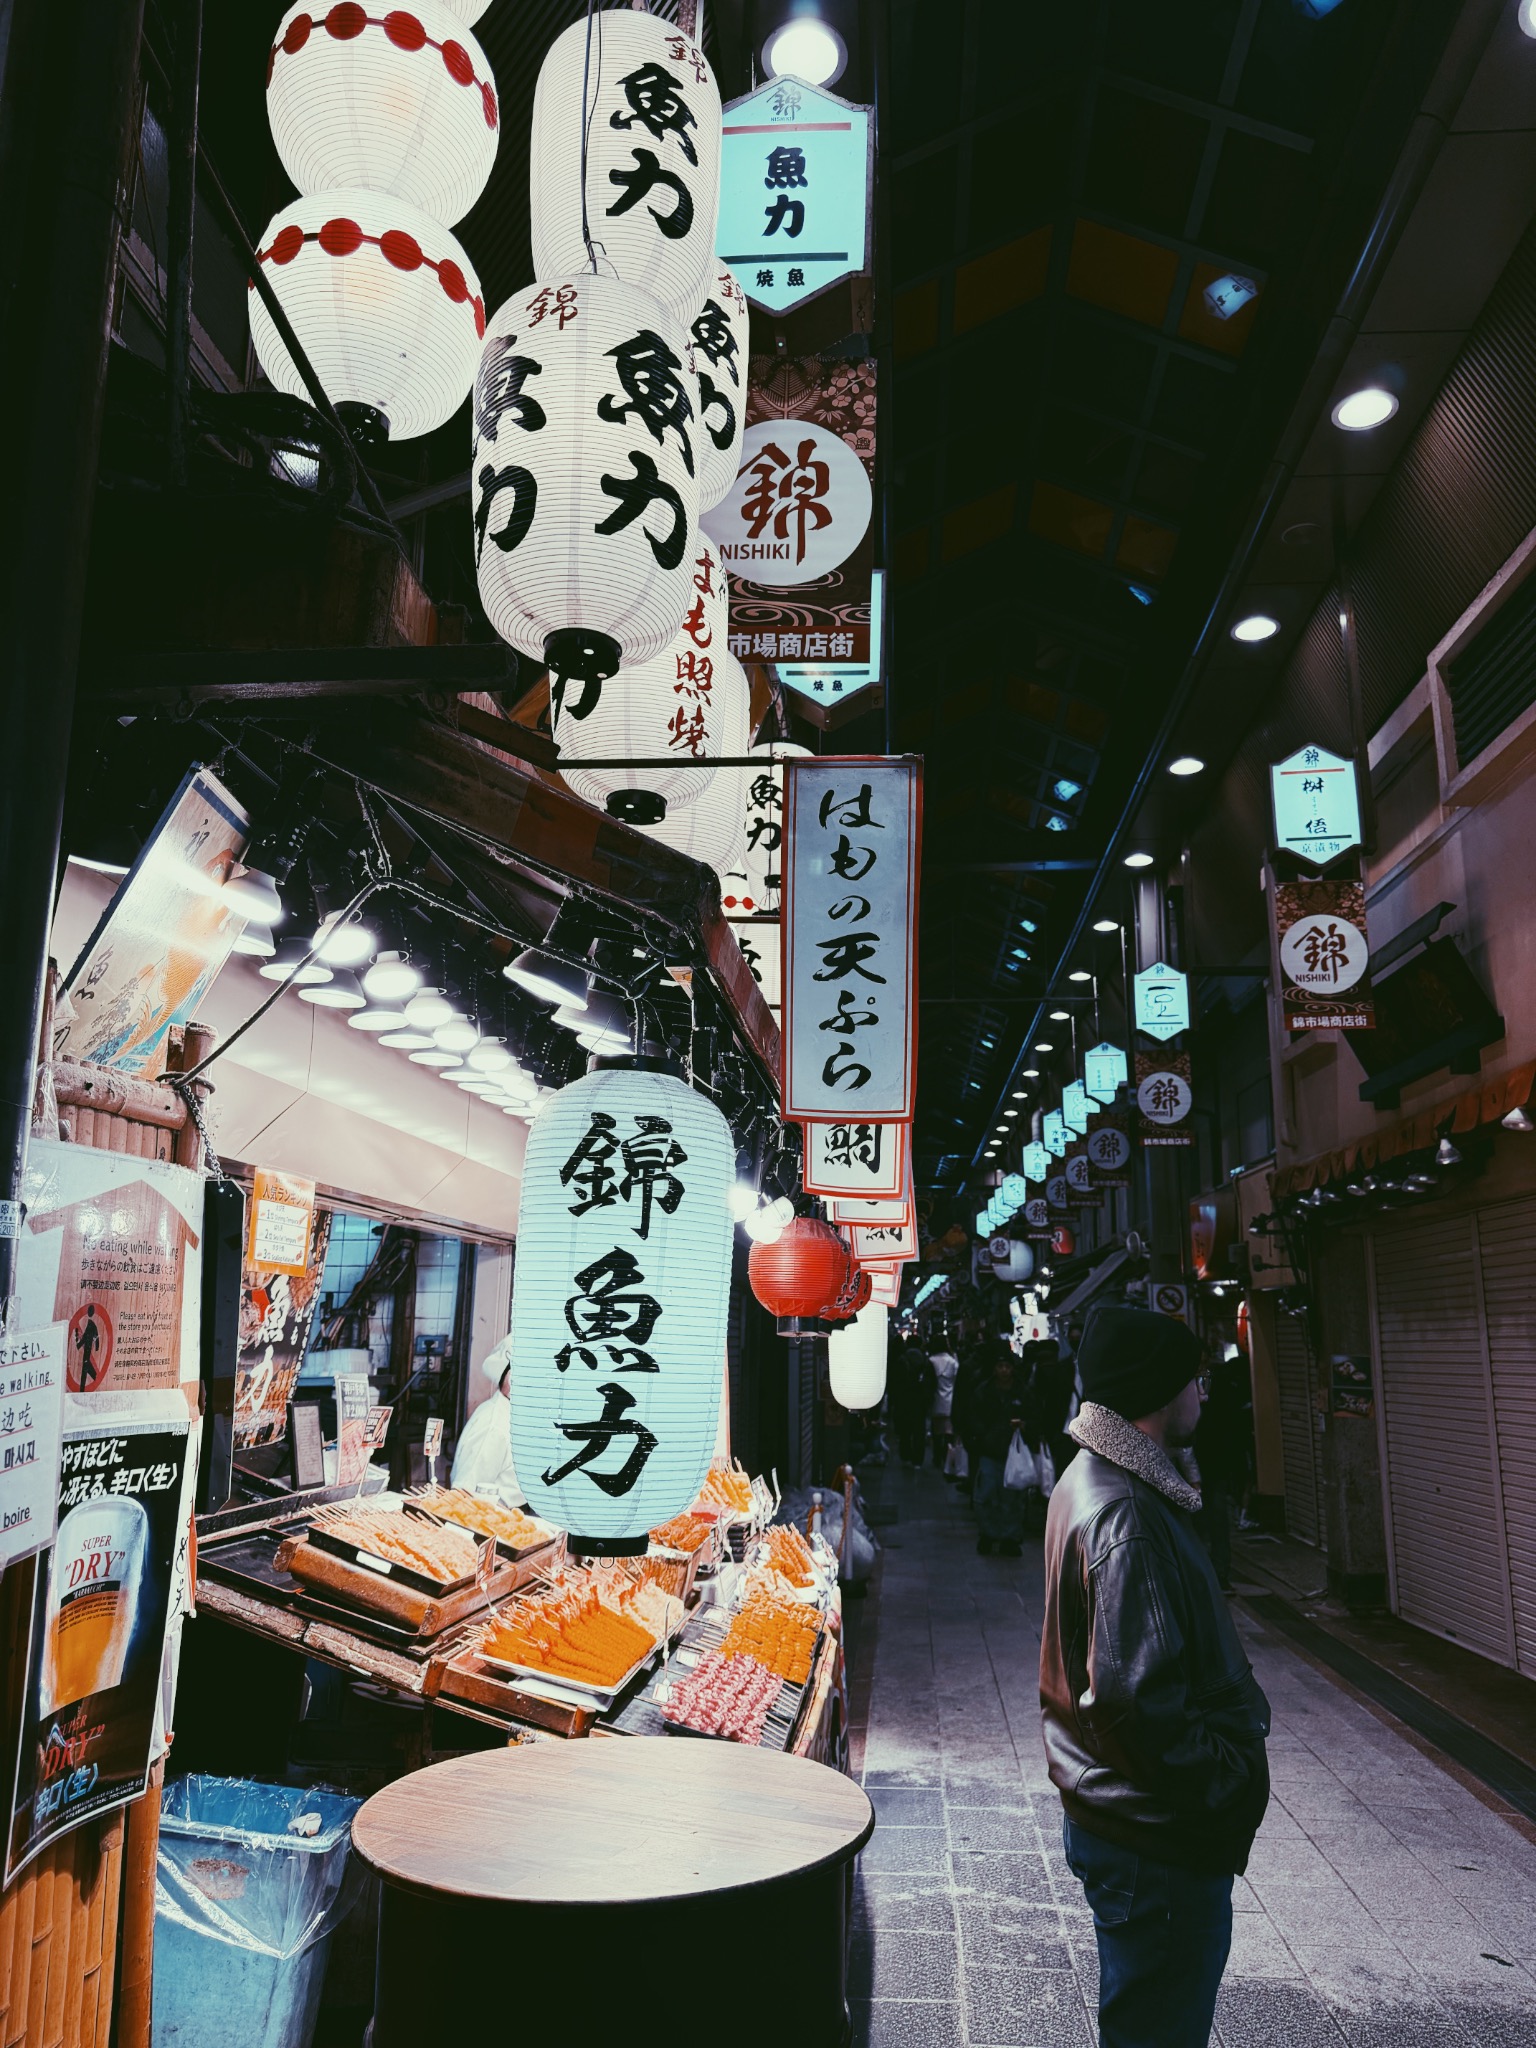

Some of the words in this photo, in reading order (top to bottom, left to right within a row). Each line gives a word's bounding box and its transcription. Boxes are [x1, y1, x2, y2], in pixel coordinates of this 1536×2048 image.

[605, 62, 699, 240] 魚力
[762, 146, 808, 239] 魚力
[756, 268, 806, 289] 焼魚
[525, 283, 579, 331] 錦
[594, 329, 695, 571] 魚力
[735, 438, 833, 567] 錦
[719, 543, 790, 560] NISHIKI
[812, 784, 888, 1092] はもの天ぷら
[1292, 923, 1350, 985] 錦
[1295, 973, 1331, 983] NISHIKI
[1292, 1014, 1367, 1028] 錦市場商店街
[1145, 1077, 1181, 1118] 錦
[100, 1238, 128, 1256] eating
[130, 1240, 152, 1255] while
[541, 1111, 688, 1498] 錦魚力
[10, 1370, 54, 1394] walking.
[3, 1506, 31, 1529] boire
[81, 1535, 112, 1552] SUPER
